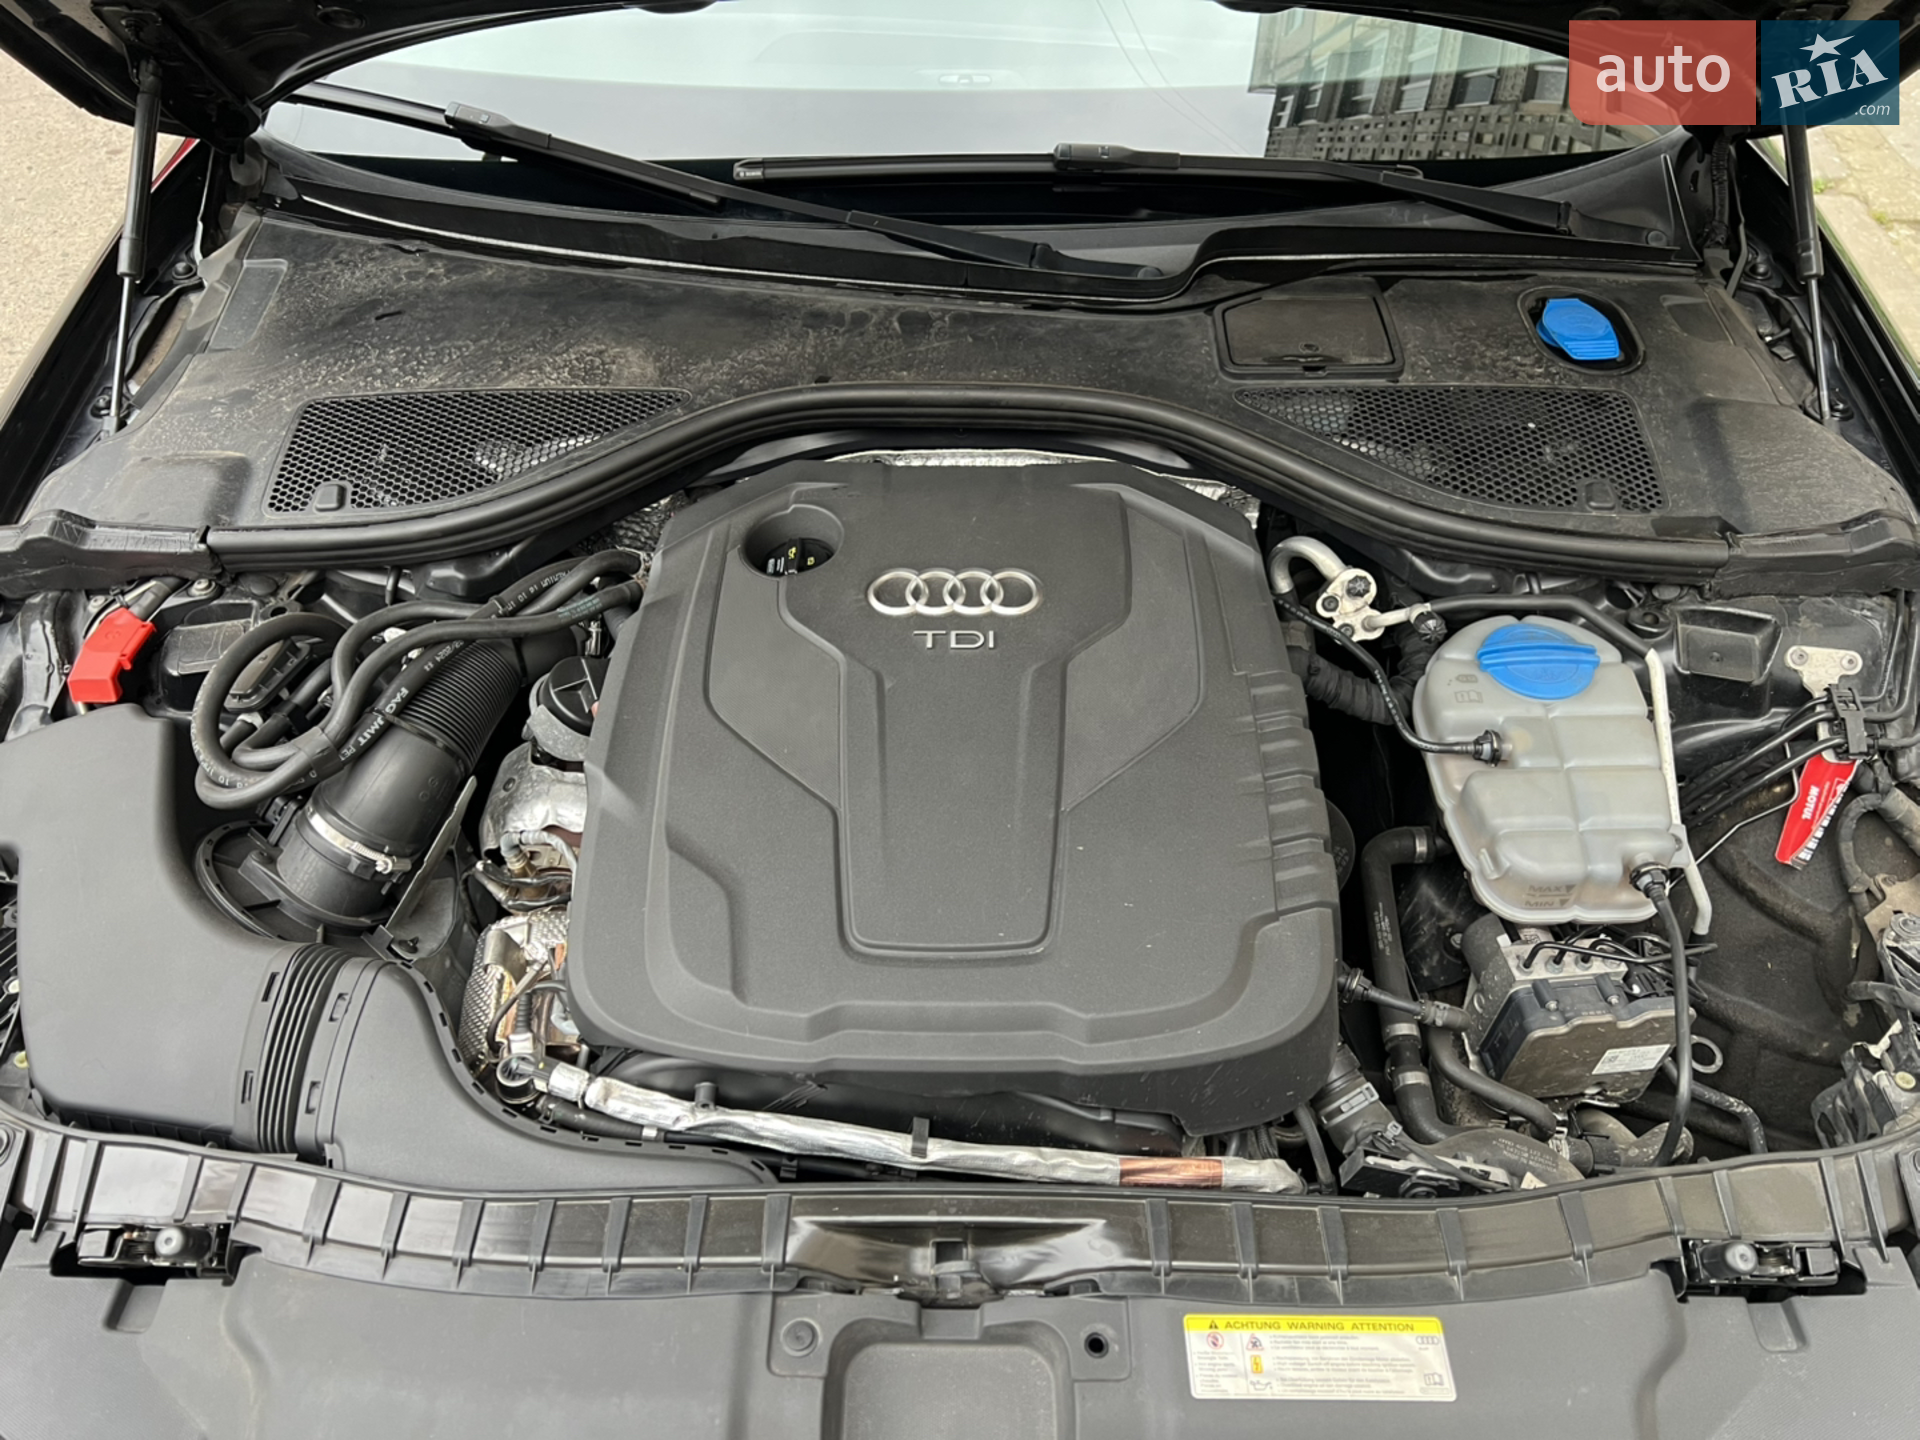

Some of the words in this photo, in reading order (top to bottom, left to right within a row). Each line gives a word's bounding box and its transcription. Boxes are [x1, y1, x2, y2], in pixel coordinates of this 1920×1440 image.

[912, 630, 995, 649] TDI
[1801, 784, 1820, 820] MOTUL
[1528, 884, 1563, 893] MAX
[1524, 900, 1555, 908] MIN
[1224, 1320, 1281, 1330] ACHTUNG
[1286, 1321, 1345, 1331] WARNING
[1350, 1322, 1415, 1332] ATTENTION
